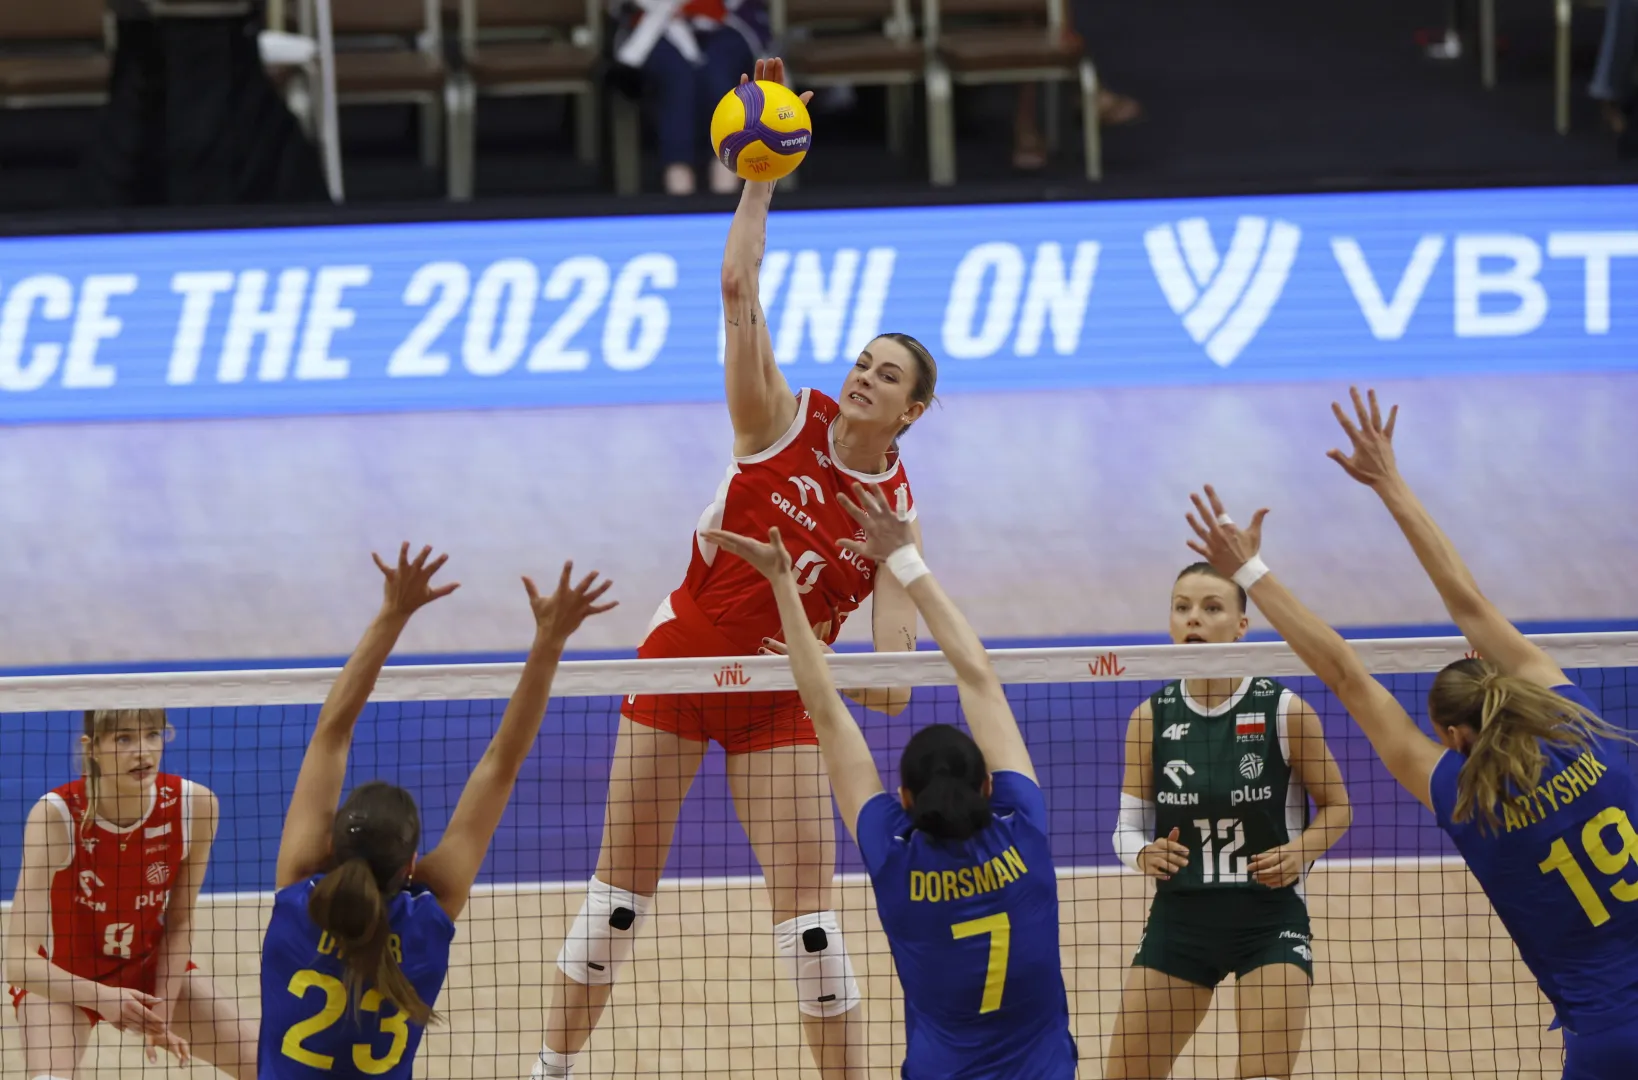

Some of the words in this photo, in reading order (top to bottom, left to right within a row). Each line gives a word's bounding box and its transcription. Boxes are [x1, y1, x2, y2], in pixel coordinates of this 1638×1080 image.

[781, 136, 808, 147] MIKASA
[166, 265, 372, 385] THE
[387, 253, 677, 377] 2026
[941, 241, 1100, 359] ON
[771, 492, 817, 532] ORLEN
[713, 662, 752, 688] VNL
[1088, 651, 1126, 677] VNL
[1161, 722, 1191, 740] 4F
[1157, 791, 1199, 805] ORLEN
[1231, 785, 1272, 806] plus
[1502, 751, 1608, 833] ARTYSHUK
[1193, 818, 1248, 884] 12
[1538, 806, 1638, 927] 19
[910, 845, 1029, 903] DORSMAN
[102, 922, 134, 960] 8
[950, 911, 1011, 1015] 7
[280, 968, 410, 1076] 23
